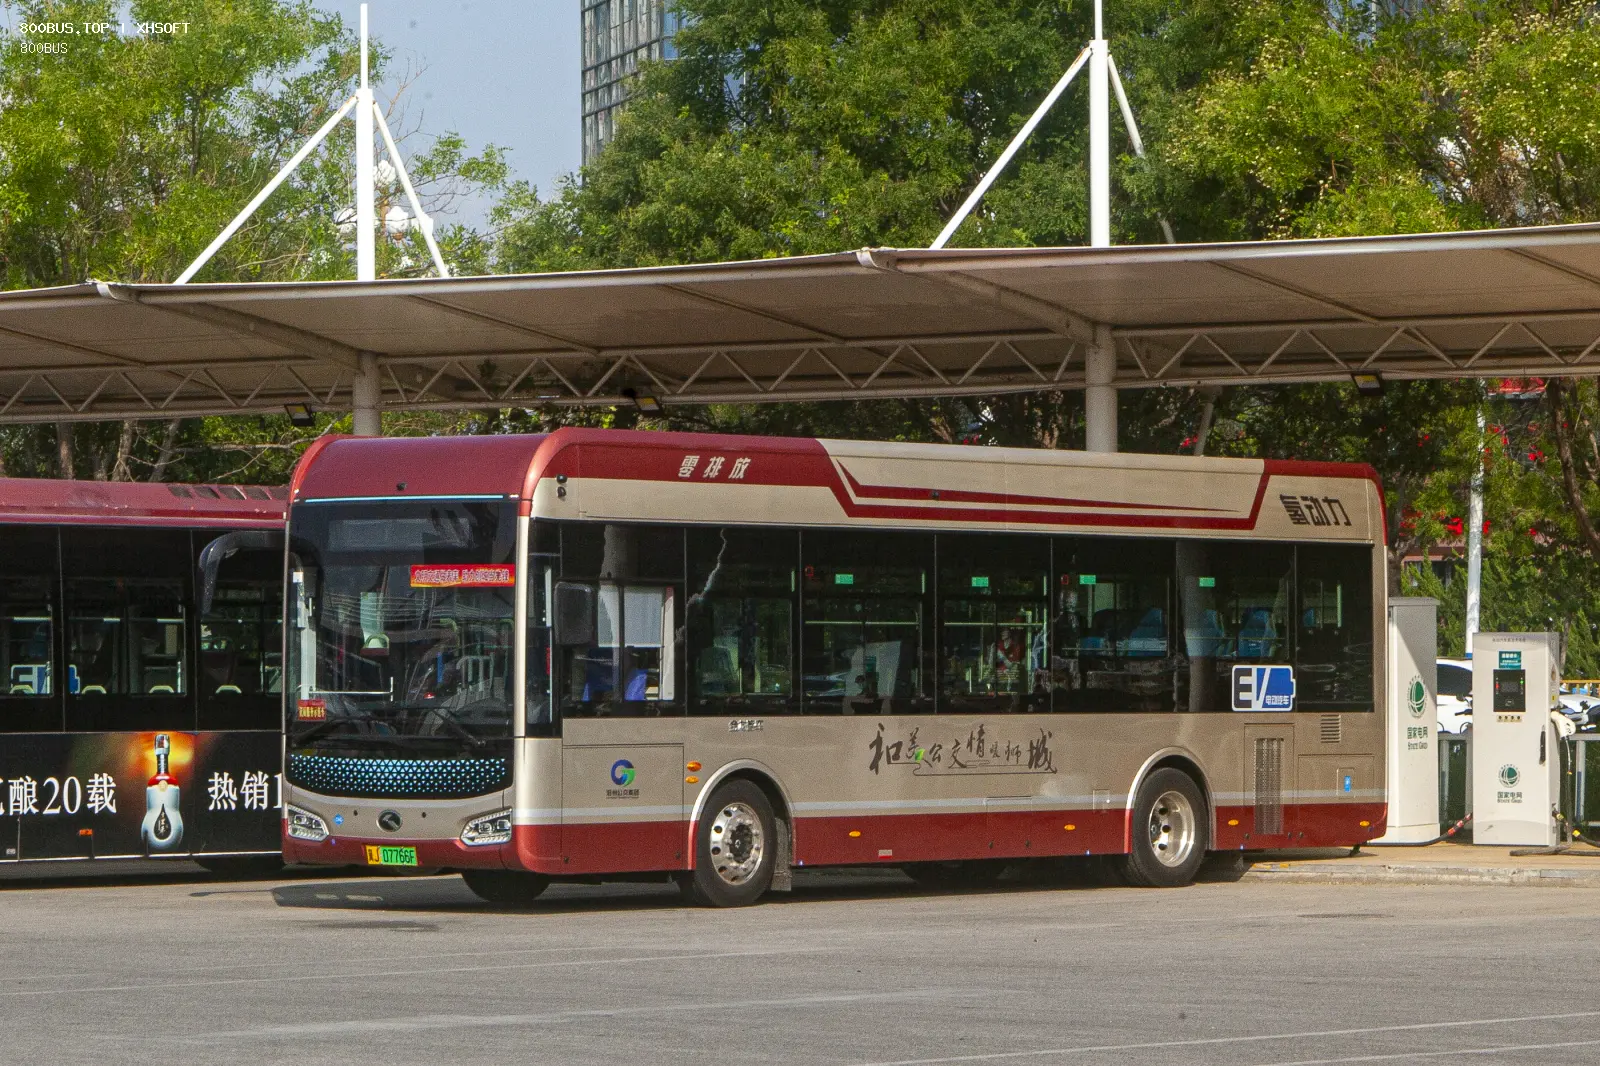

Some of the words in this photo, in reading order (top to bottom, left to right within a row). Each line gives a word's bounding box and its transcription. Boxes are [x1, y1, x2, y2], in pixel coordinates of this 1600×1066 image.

[678, 455, 751, 479] 零排放
[1280, 493, 1352, 526] 氢动力
[1234, 667, 1271, 709] EV
[1407, 726, 1428, 740] 国家电网
[0, 773, 117, 816] 酿20载
[1497, 791, 1523, 799] 国家电网
